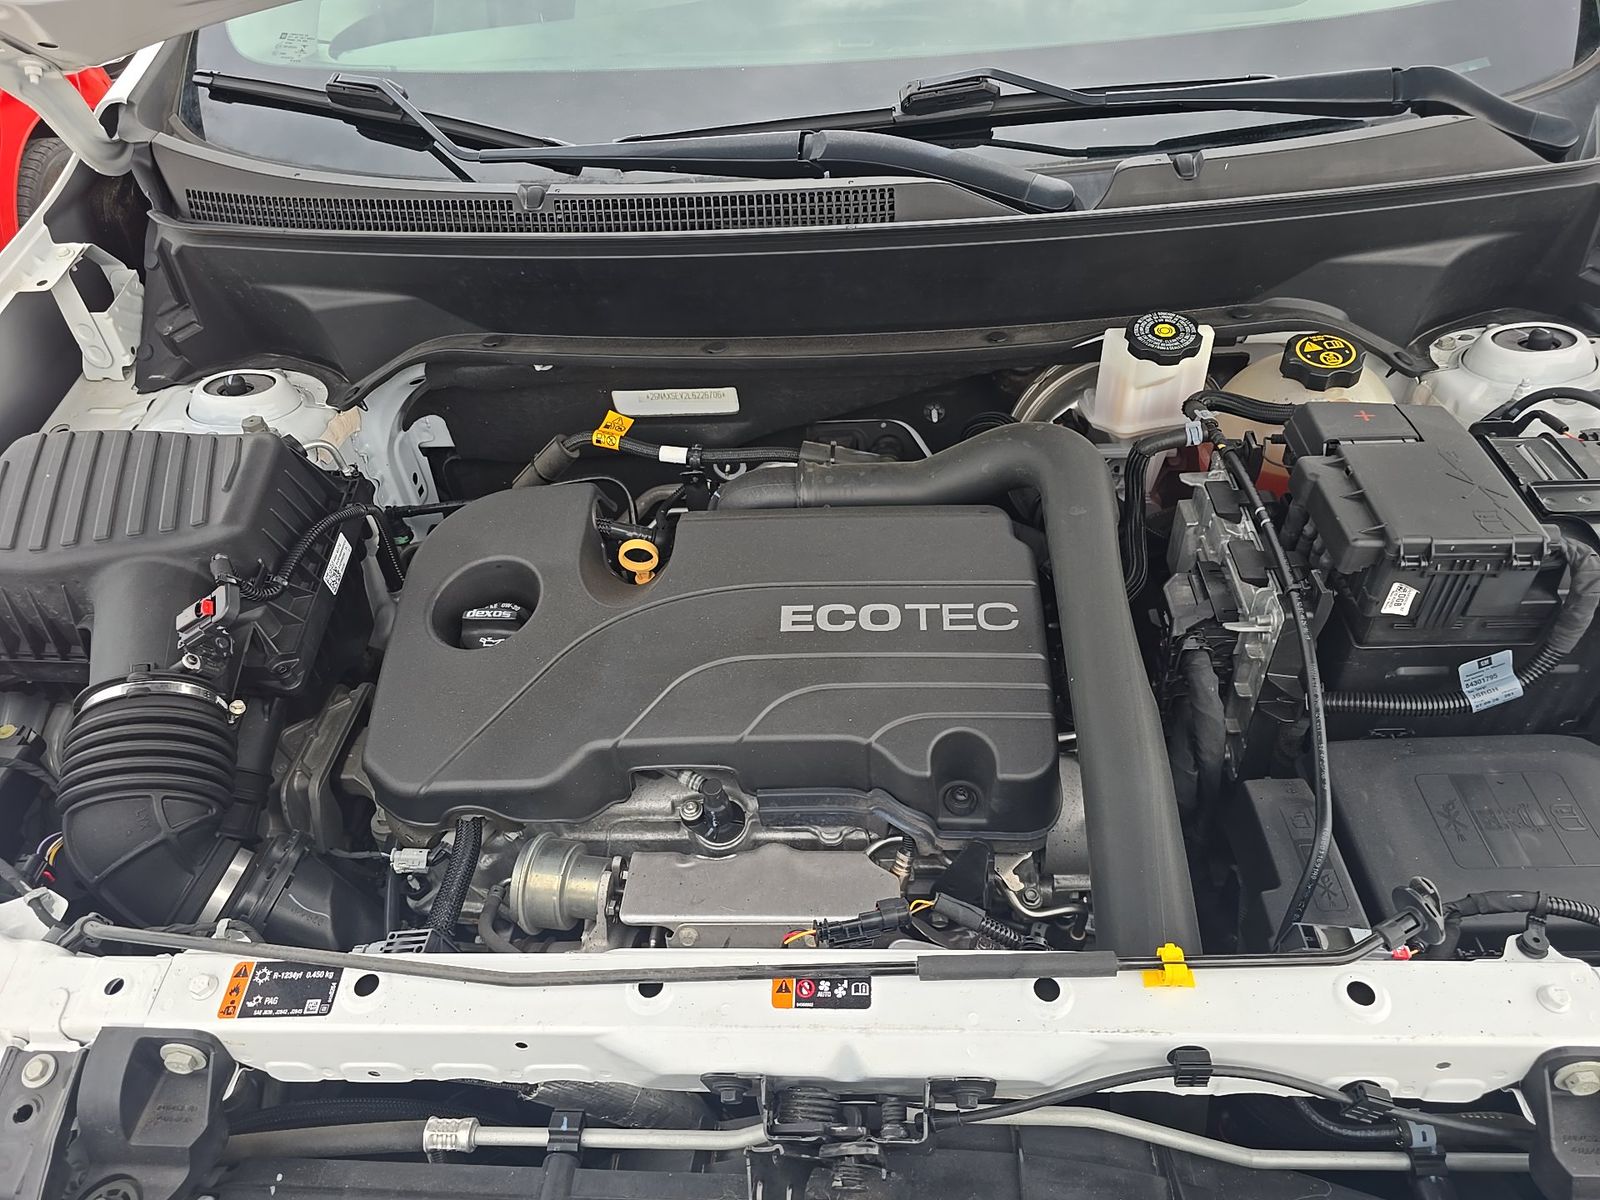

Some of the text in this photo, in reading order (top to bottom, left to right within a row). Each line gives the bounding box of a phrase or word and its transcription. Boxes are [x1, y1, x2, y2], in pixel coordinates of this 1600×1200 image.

[466, 608, 511, 618] dexos
[780, 602, 1019, 632] ECOTEC
[272, 971, 303, 980] R-1234yf
[325, 971, 334, 979] kg
[264, 997, 279, 1005] PAG
